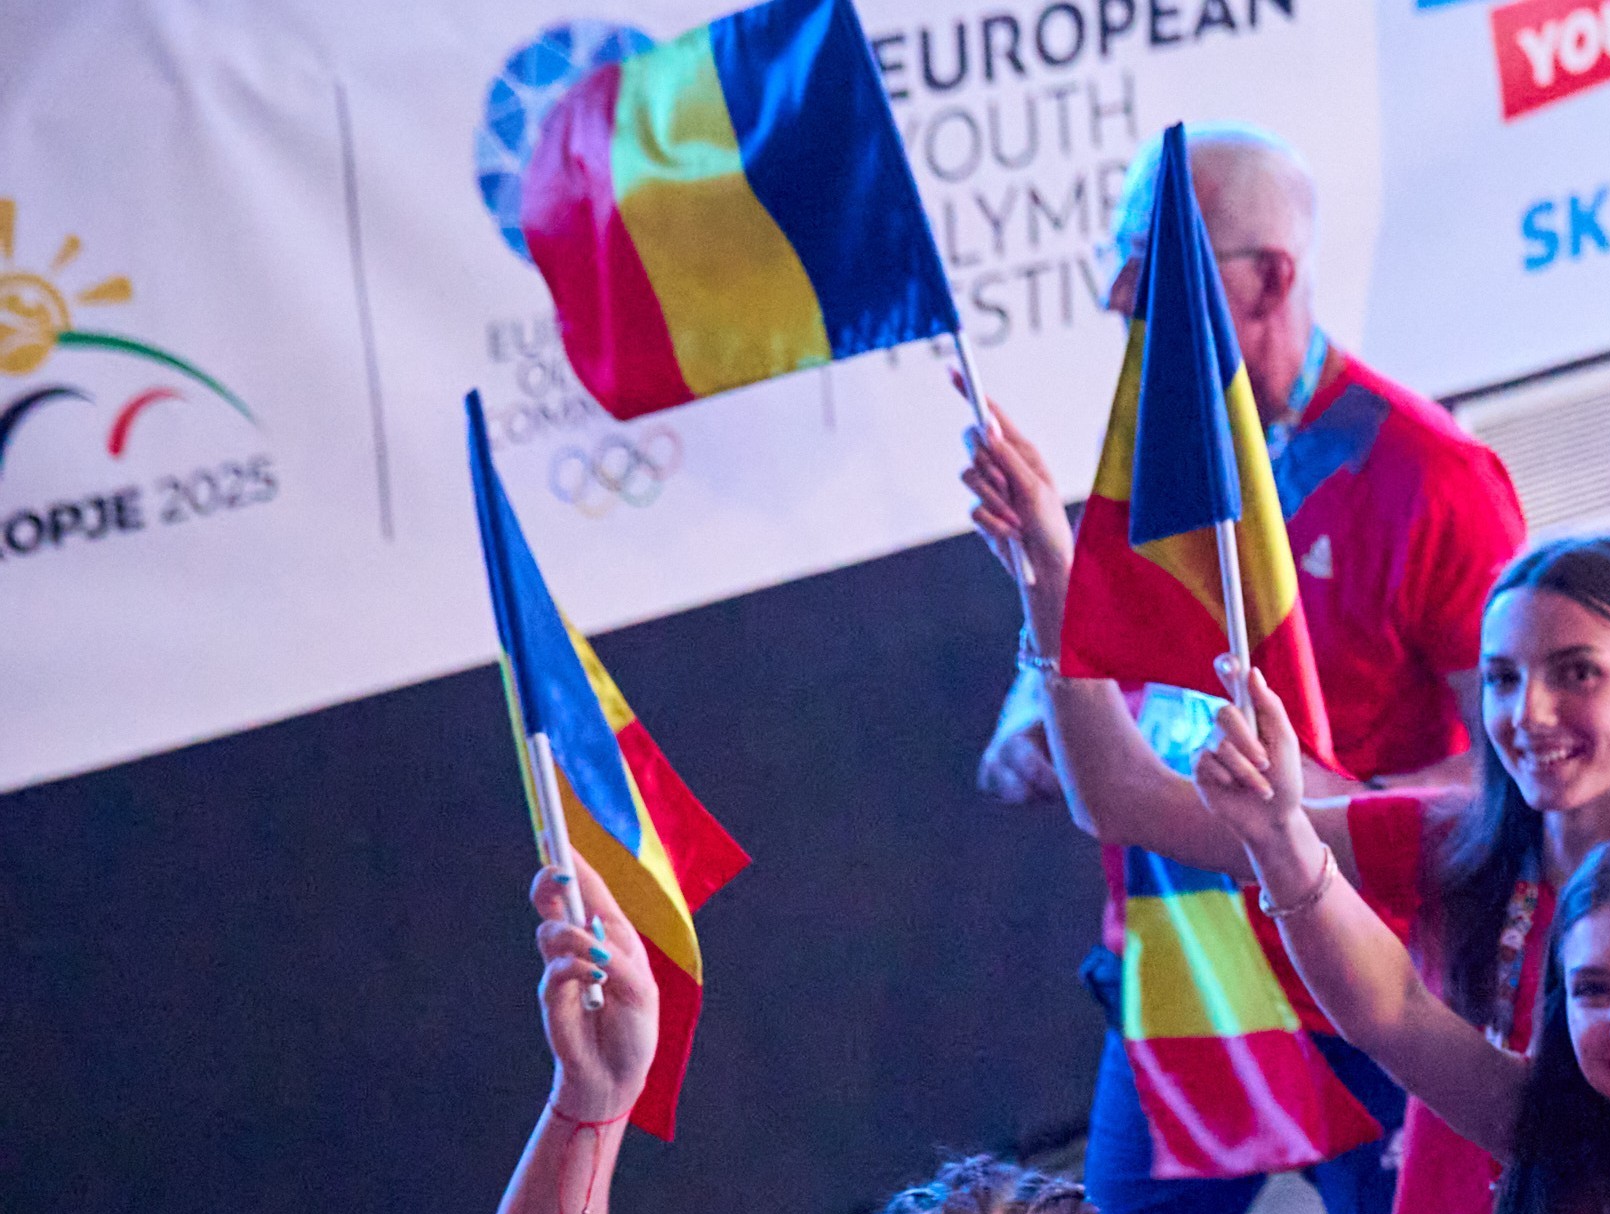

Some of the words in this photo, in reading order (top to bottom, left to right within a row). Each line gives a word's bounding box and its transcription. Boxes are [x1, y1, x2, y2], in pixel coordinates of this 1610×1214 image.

[905, 70, 1139, 183] OUTH
[0, 485, 146, 560] OPJE
[154, 454, 279, 526] 2025
